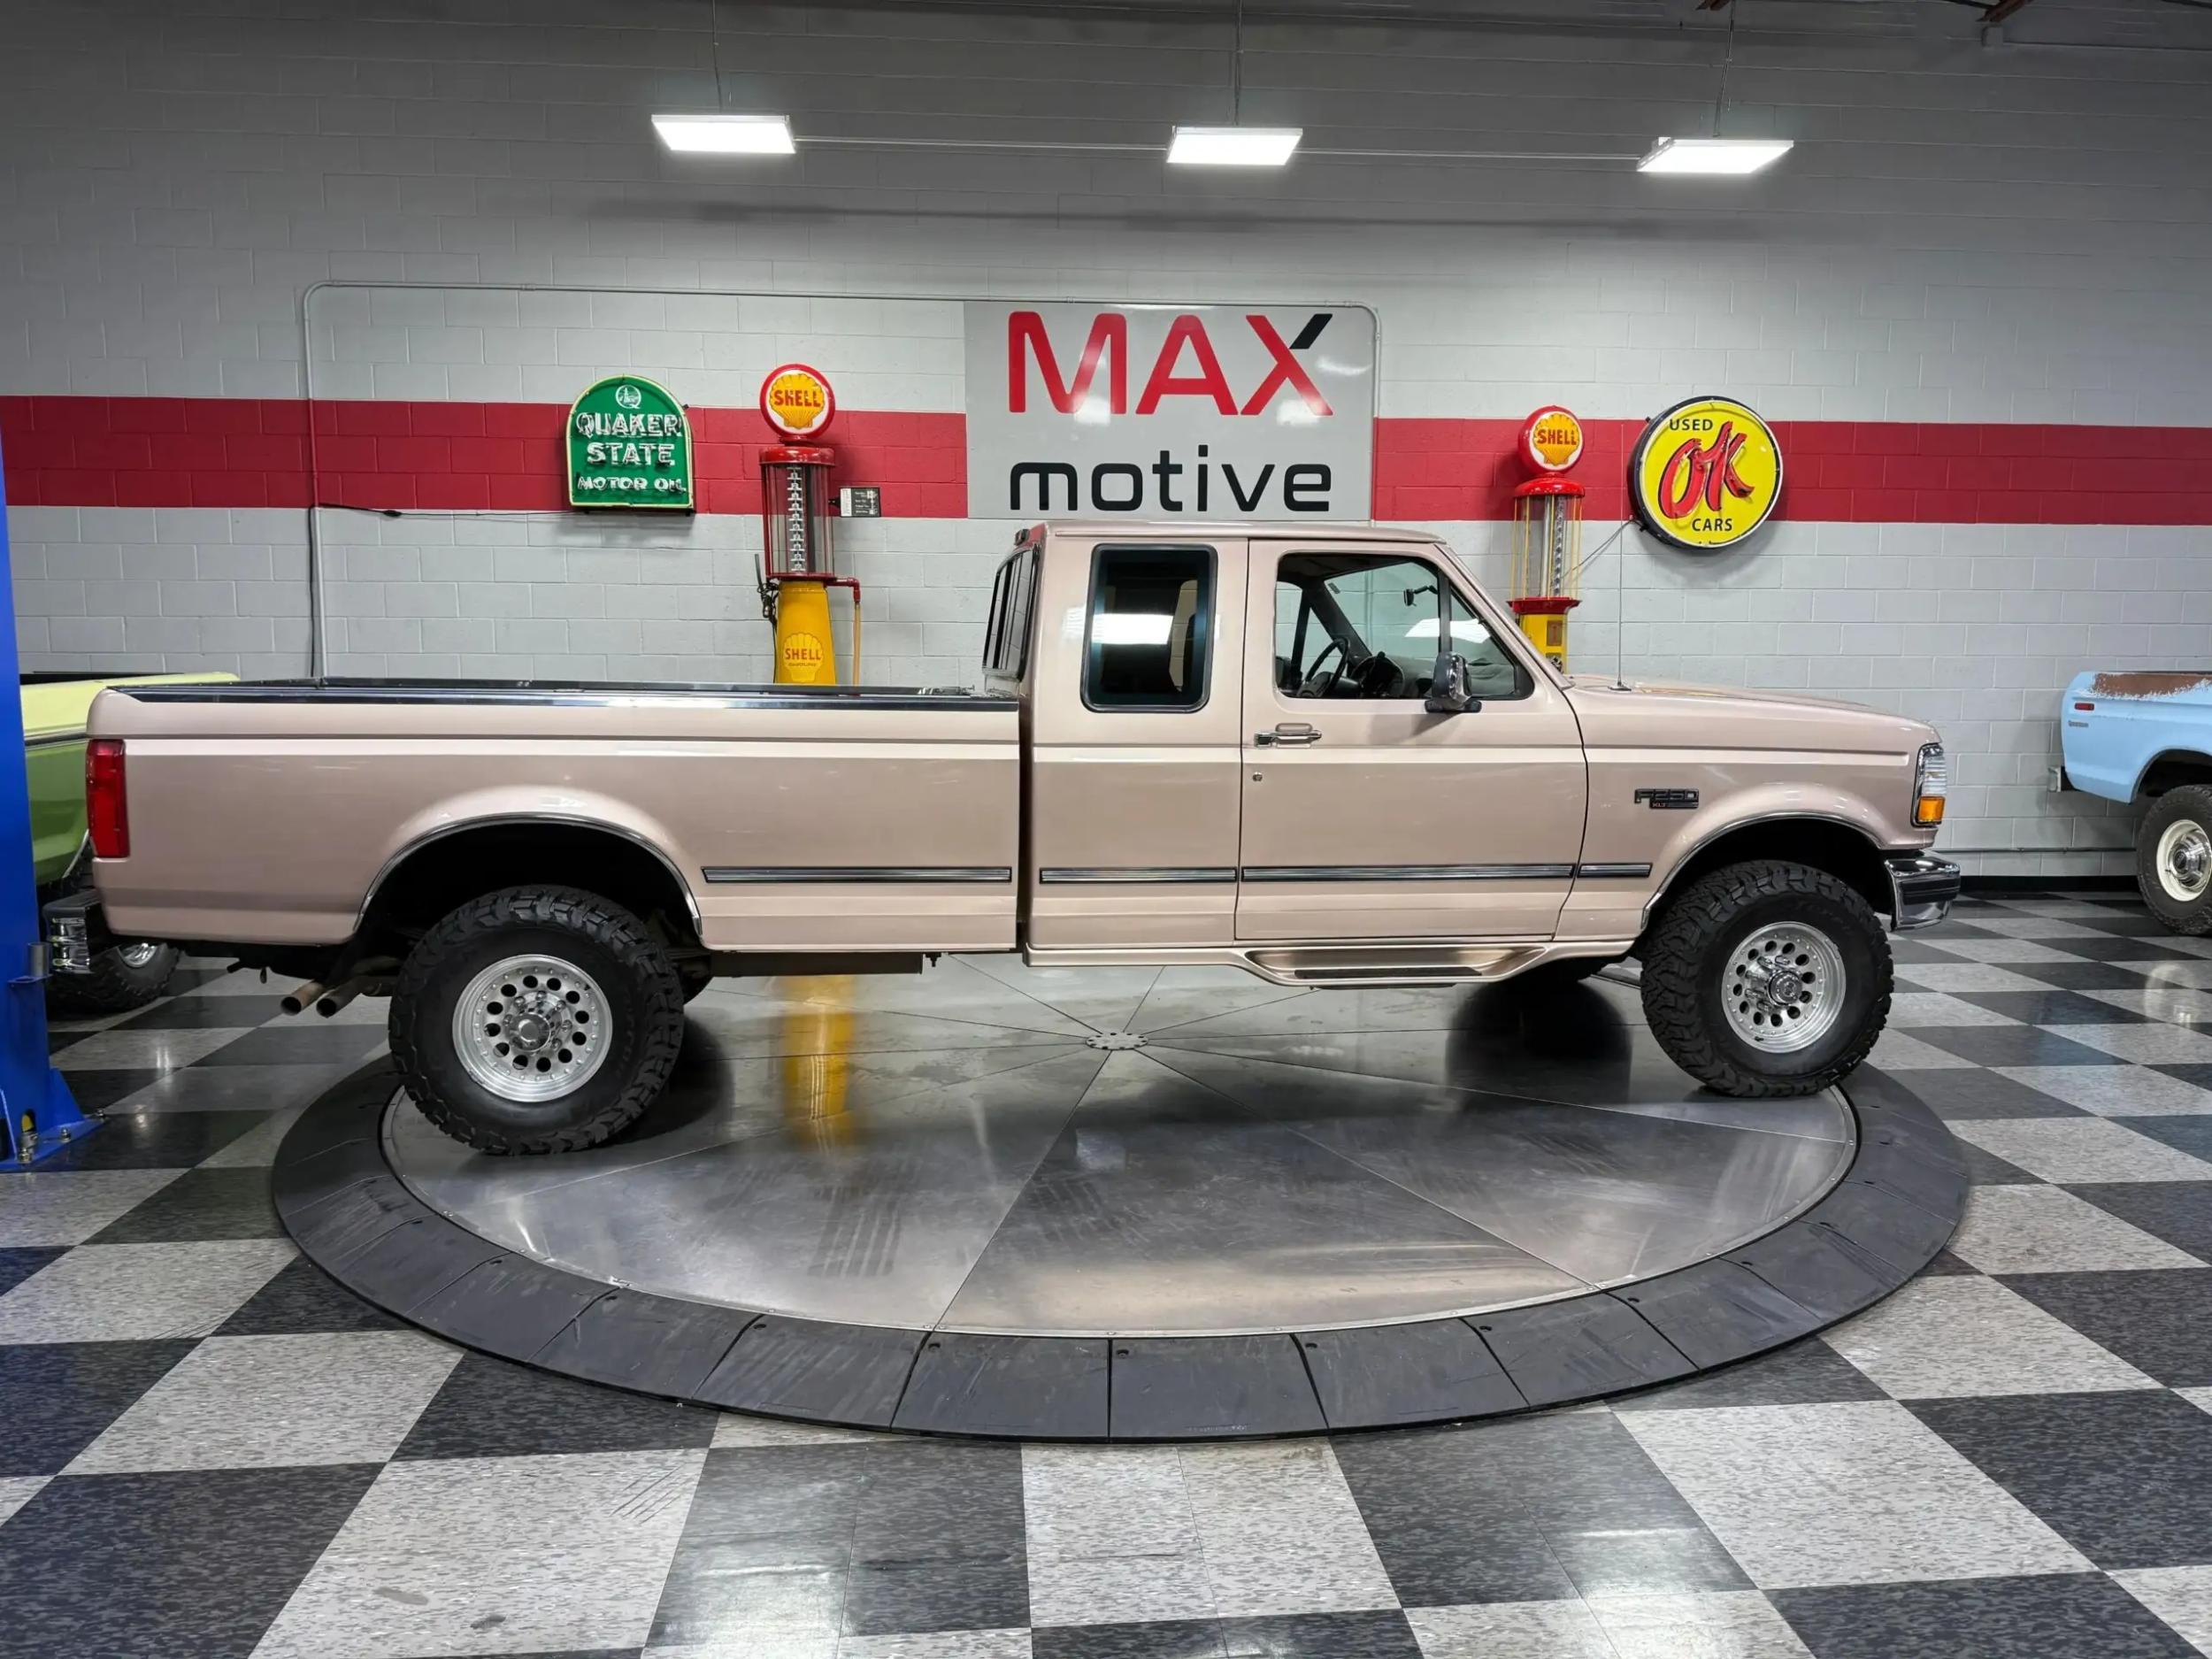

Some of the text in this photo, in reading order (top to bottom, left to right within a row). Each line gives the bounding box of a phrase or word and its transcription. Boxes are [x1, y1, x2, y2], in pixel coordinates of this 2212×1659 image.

[1009, 311, 1333, 416] MAX
[774, 389, 821, 407] SHELL
[576, 411, 682, 439] QUAKER
[1670, 419, 1713, 432] USED
[1537, 428, 1577, 445] SHELL
[587, 442, 675, 465] STATE
[577, 476, 687, 493] MOTOR OIL
[1010, 444, 1332, 512] motive
[1692, 518, 1732, 532] CARS
[785, 648, 821, 660] SHELL
